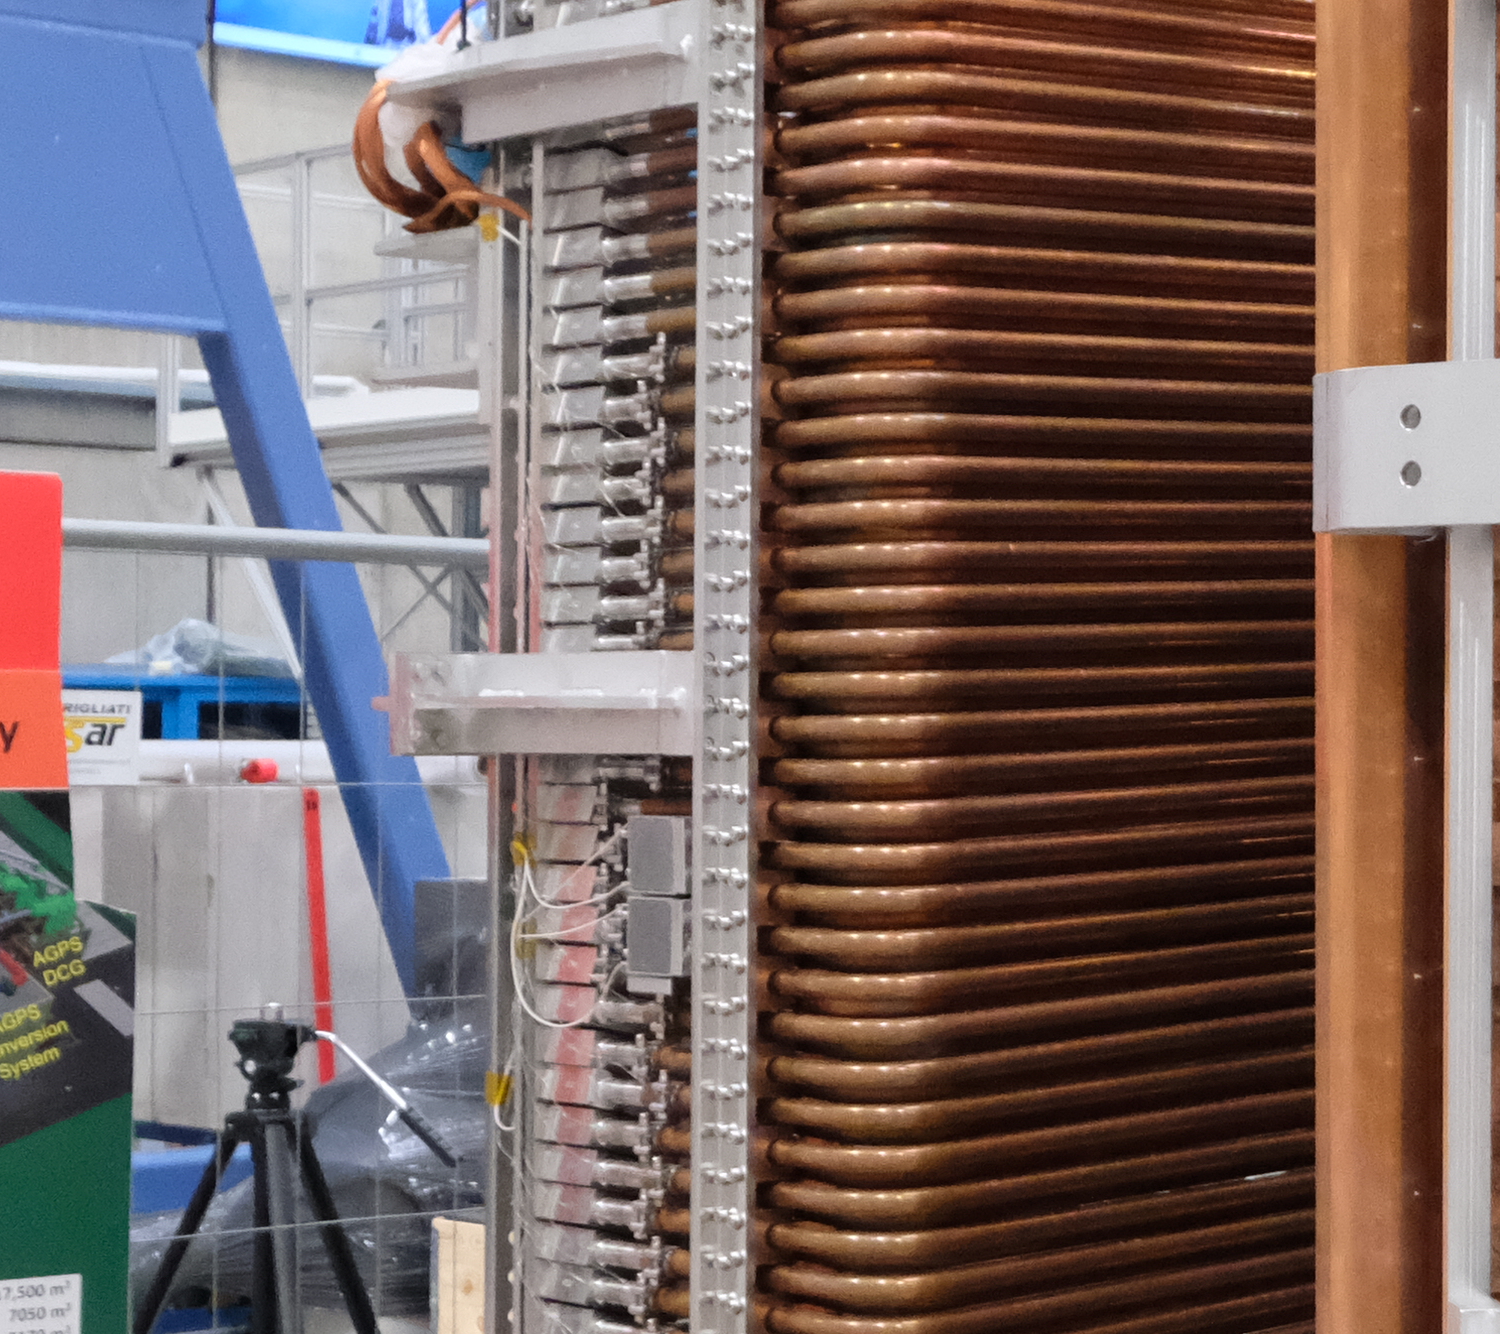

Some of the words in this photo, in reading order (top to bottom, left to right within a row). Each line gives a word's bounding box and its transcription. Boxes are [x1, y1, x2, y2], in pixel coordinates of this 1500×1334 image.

[63, 702, 132, 714] RIGLIATI
[33, 936, 84, 968] AGPS
[42, 959, 88, 987] DCG
[9, 1307, 46, 1322] 7050
